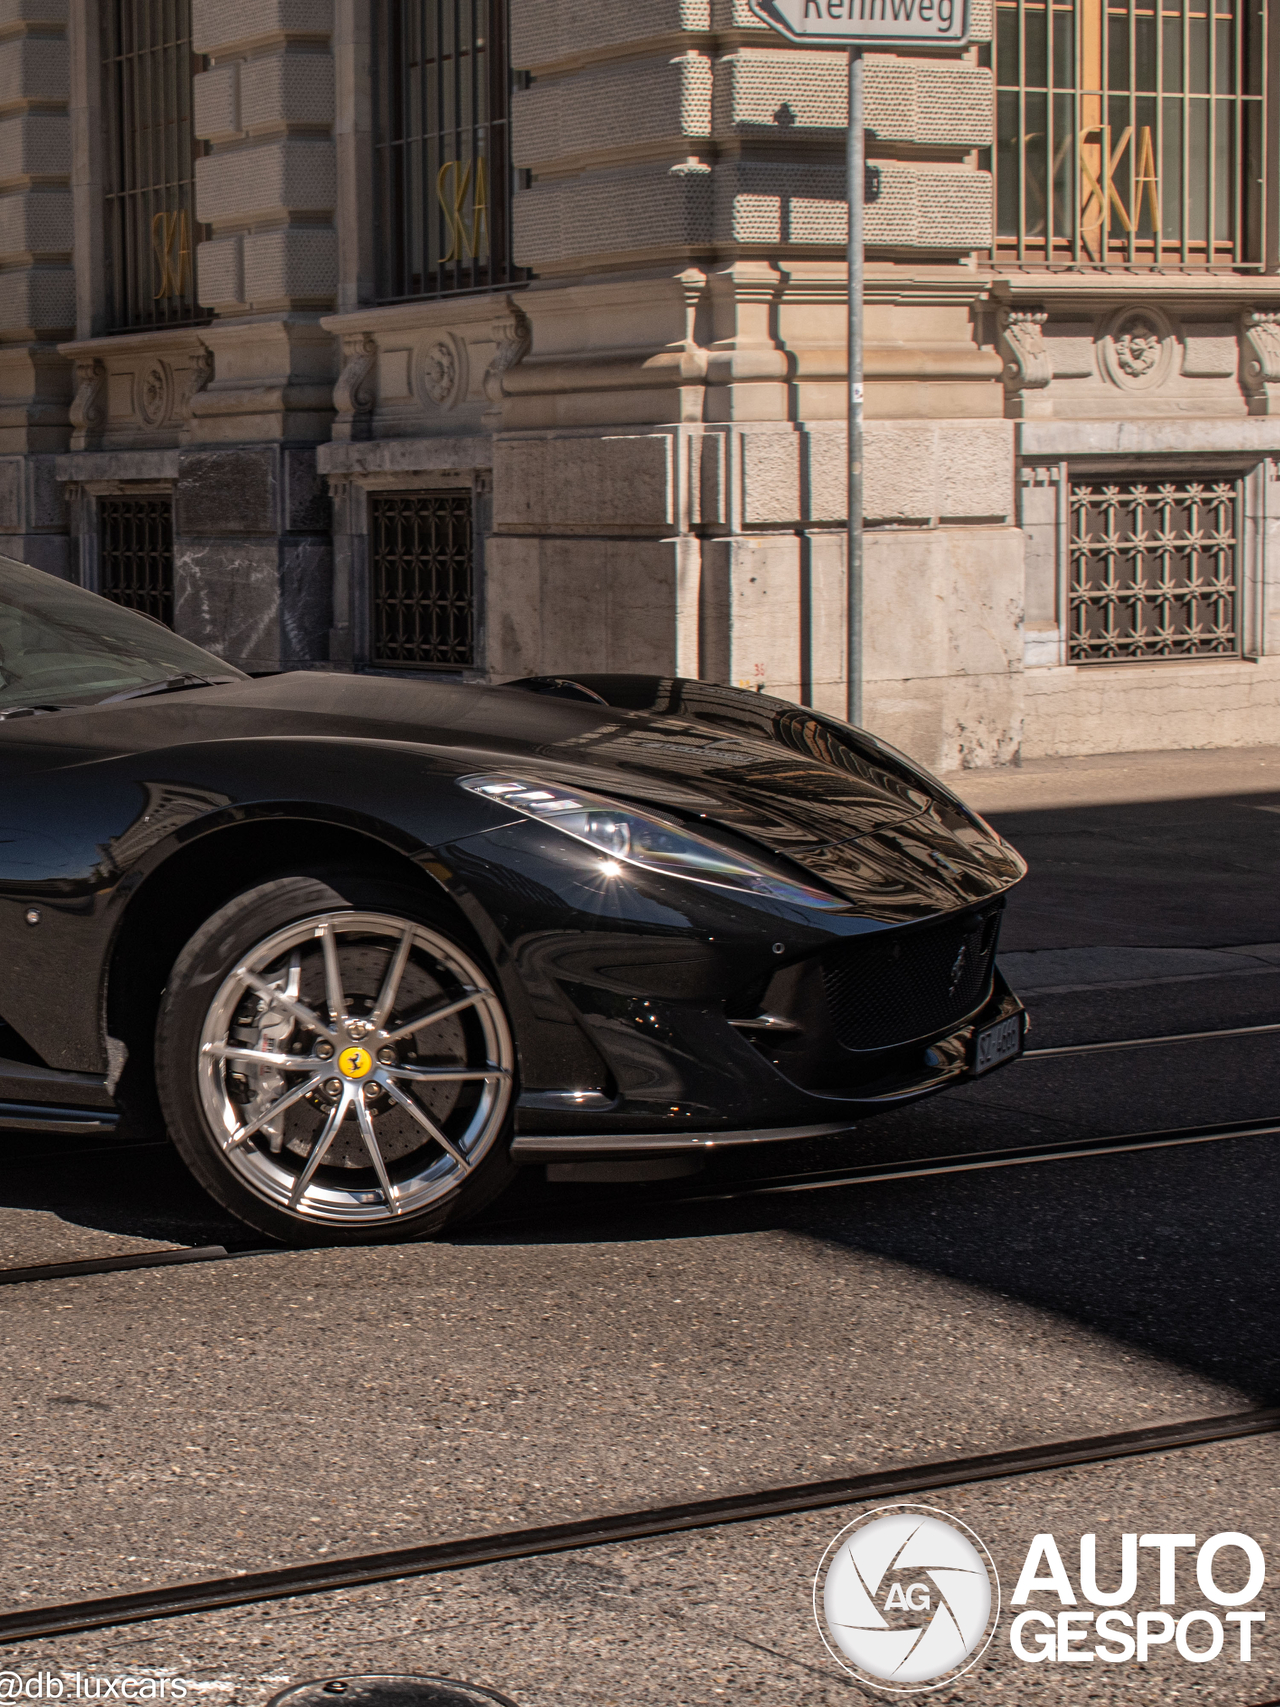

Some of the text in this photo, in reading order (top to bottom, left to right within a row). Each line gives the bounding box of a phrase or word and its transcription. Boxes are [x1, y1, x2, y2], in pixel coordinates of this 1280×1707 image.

[804, 0, 954, 32] Rennweg
[437, 157, 489, 262] SKA
[1080, 125, 1160, 232] SKA
